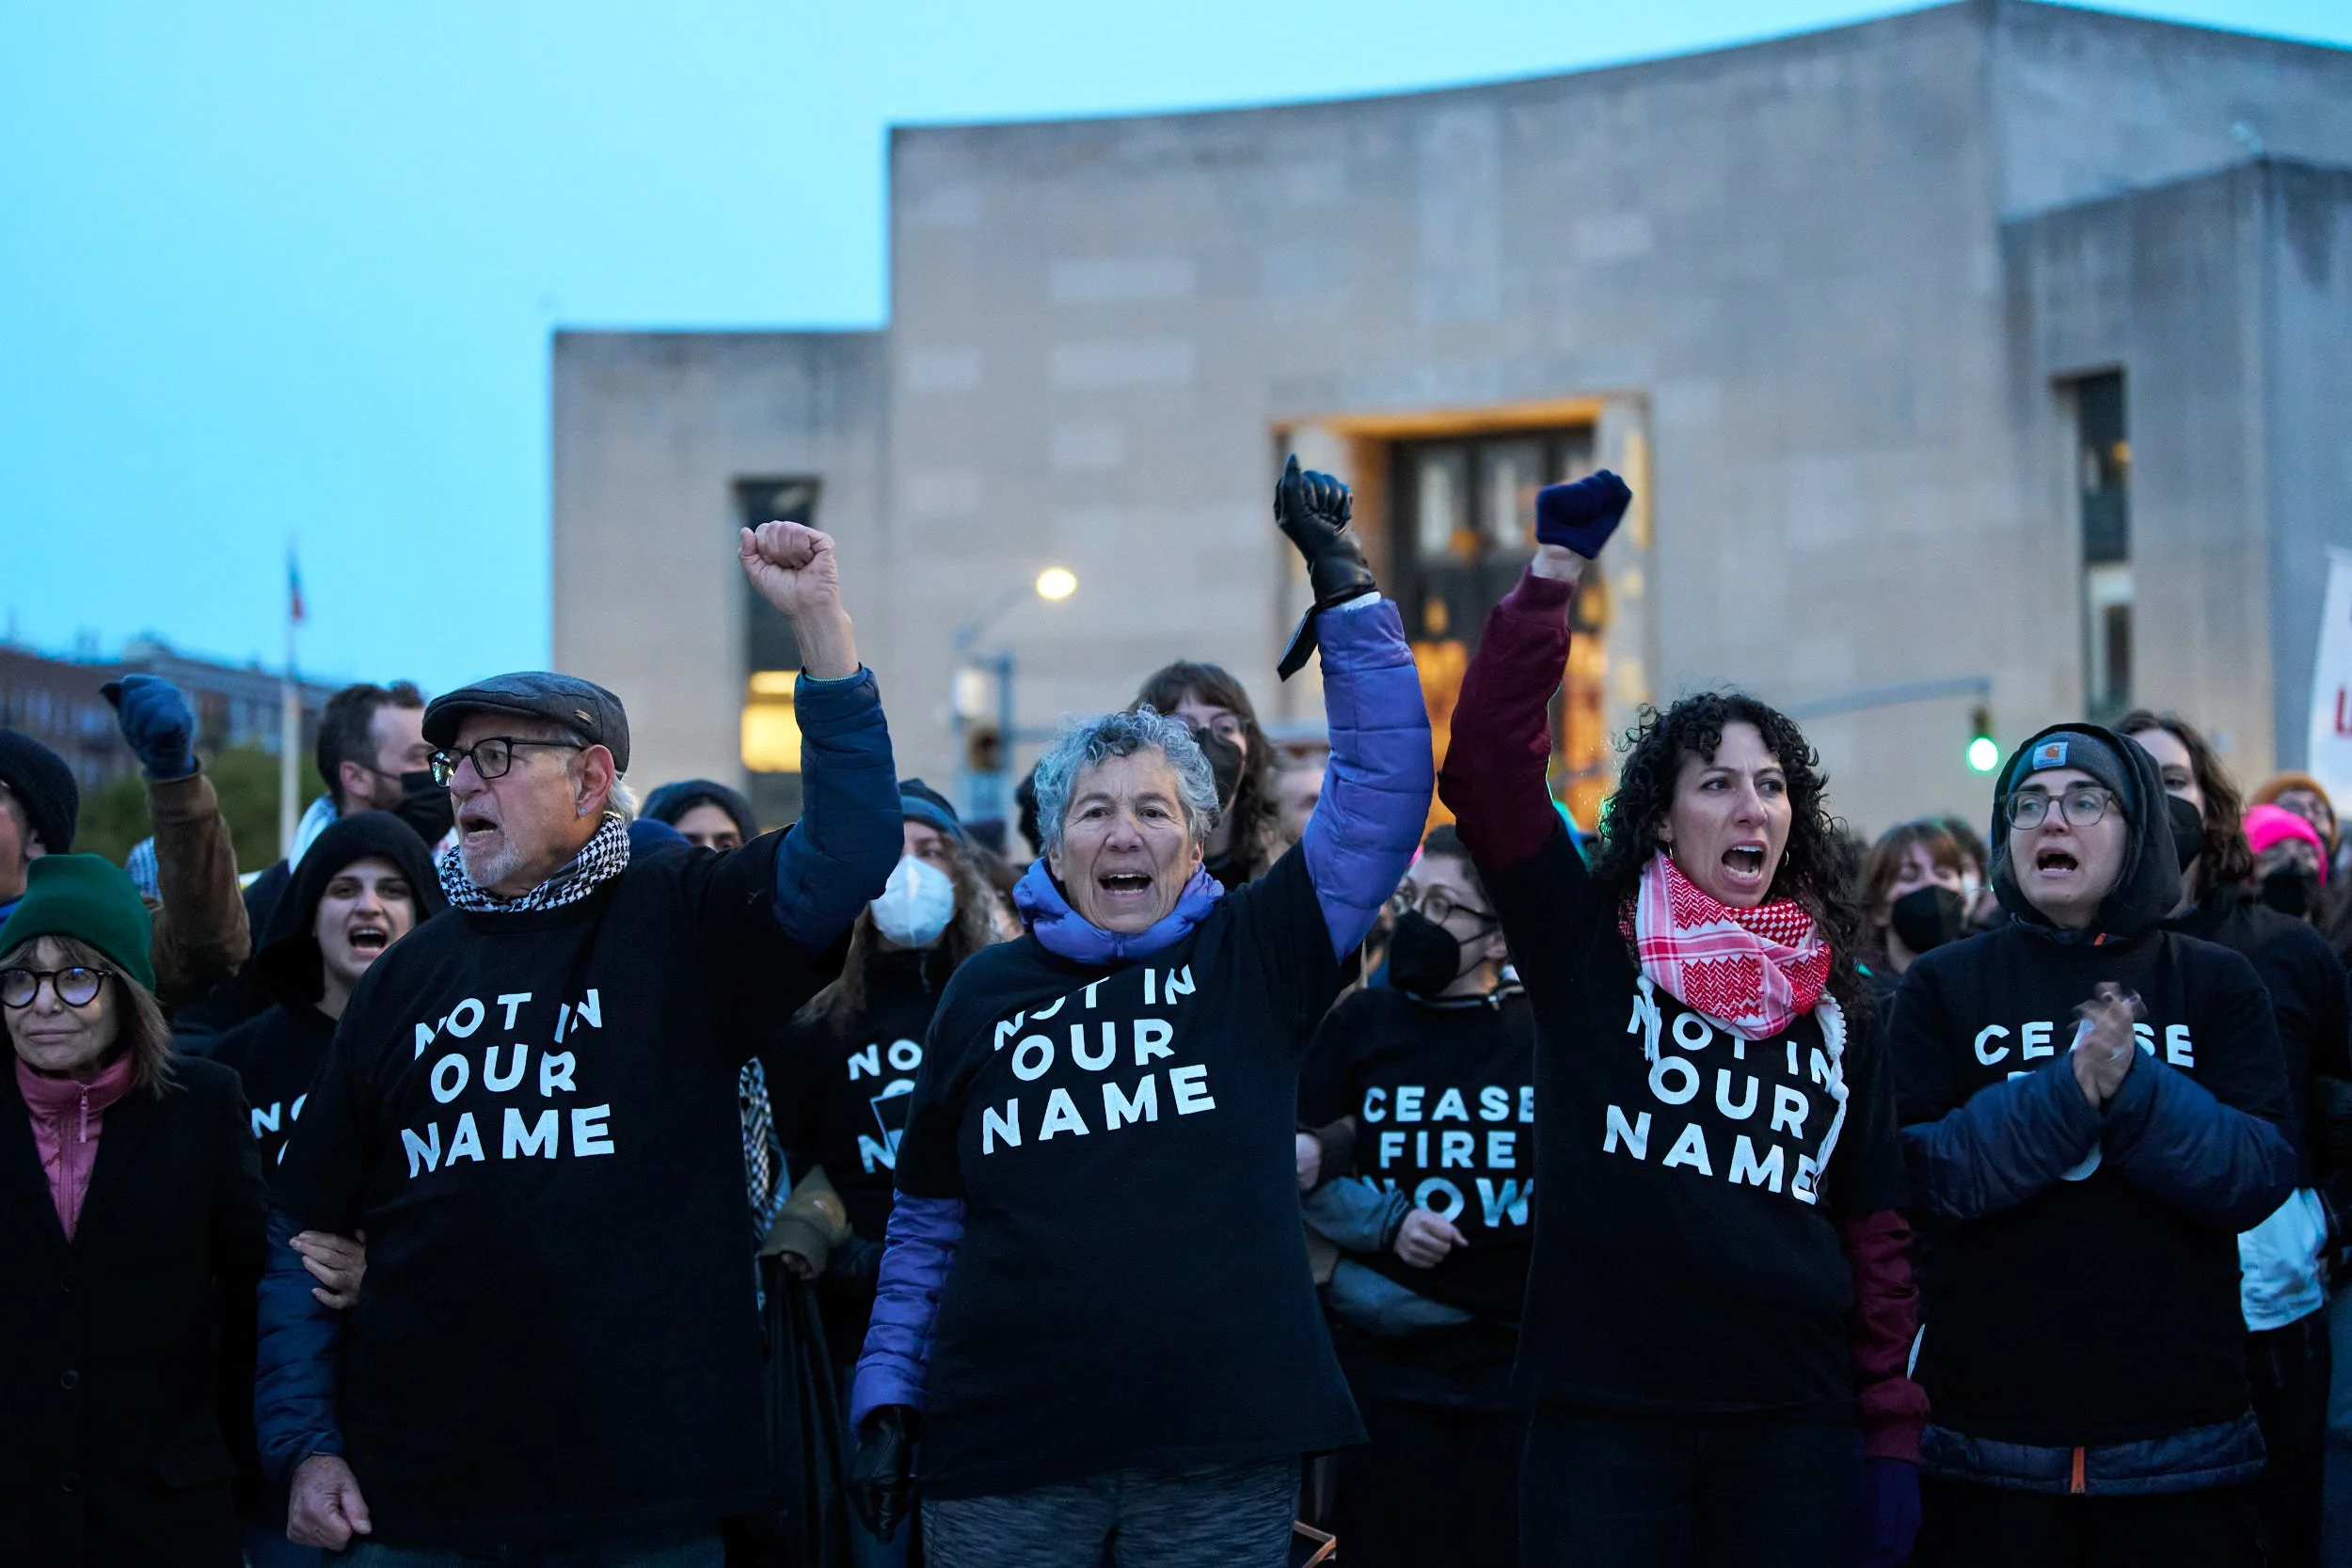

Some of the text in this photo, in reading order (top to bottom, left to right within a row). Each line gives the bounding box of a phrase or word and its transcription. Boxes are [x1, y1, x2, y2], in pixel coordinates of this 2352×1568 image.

[1144, 964, 1196, 1005] IN
[415, 989, 602, 1061] NOT IN
[1011, 1018, 1175, 1081] OUR
[430, 1043, 577, 1104] OUR
[983, 1064, 1216, 1155] NAME
[1648, 1055, 1809, 1139] OUR
[401, 1103, 614, 1179] NAME
[1379, 1131, 1516, 1168] FIRE
[1602, 1104, 1817, 1205] NAME
